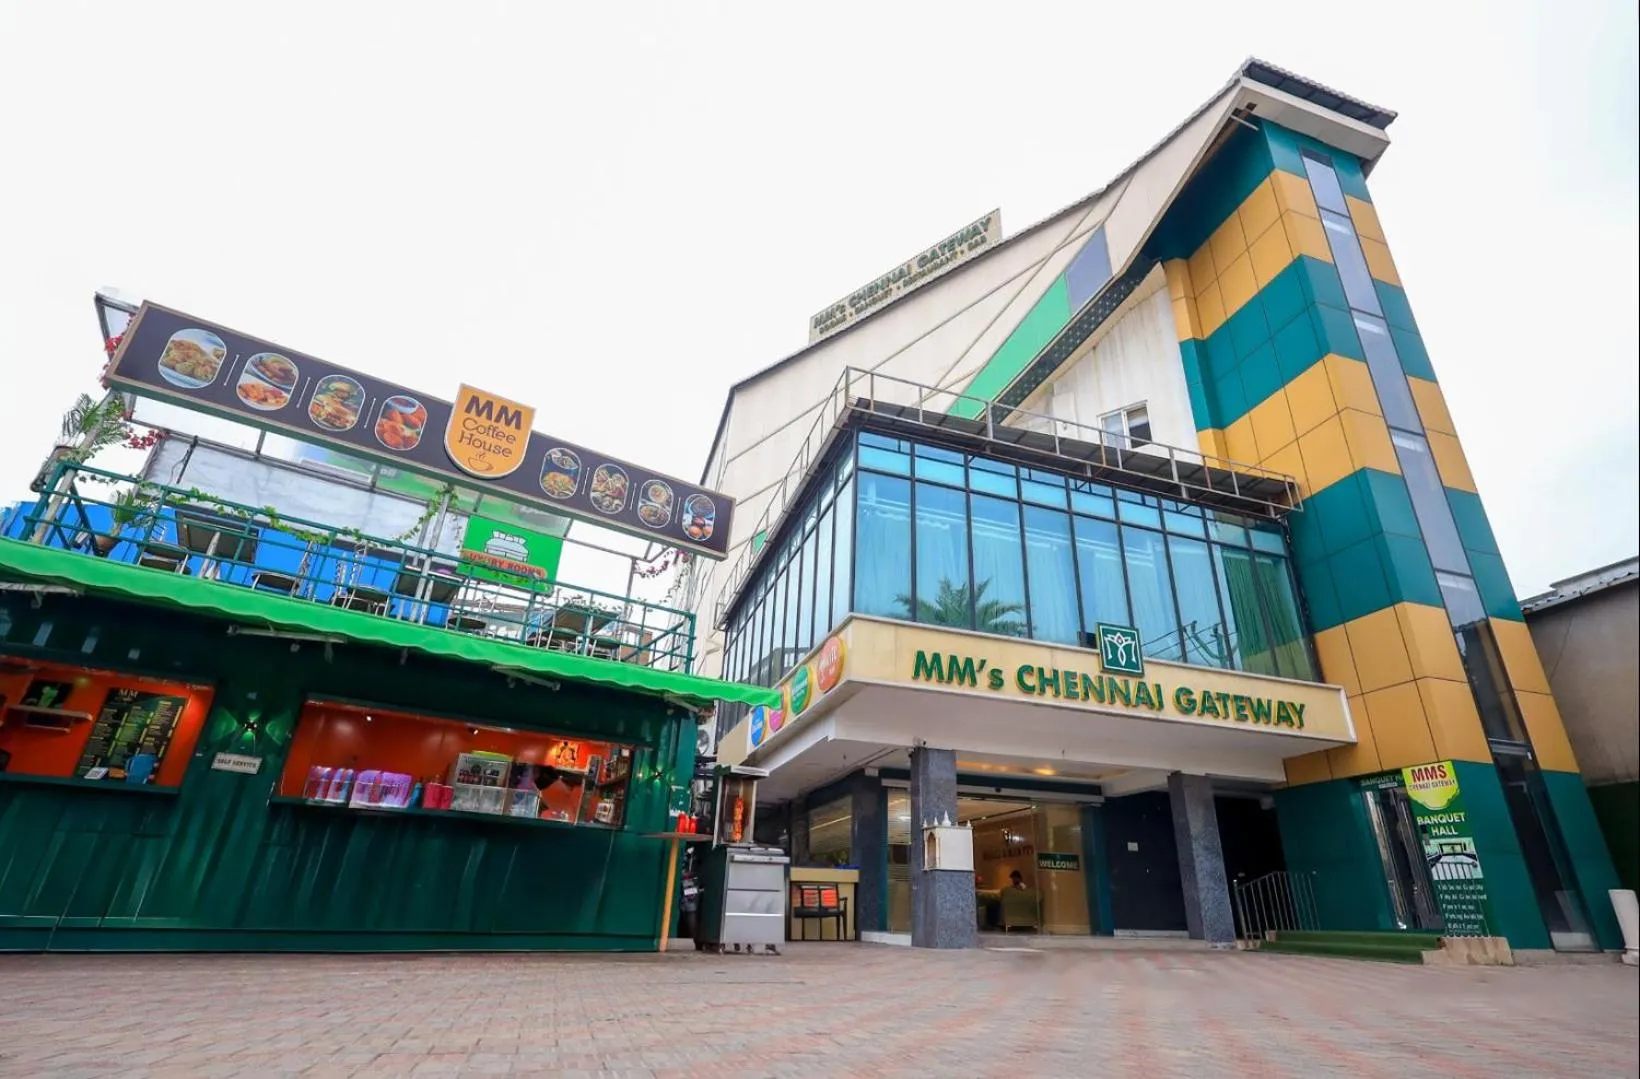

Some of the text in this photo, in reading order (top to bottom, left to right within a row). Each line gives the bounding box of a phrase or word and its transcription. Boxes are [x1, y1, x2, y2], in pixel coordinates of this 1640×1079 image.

[849, 264, 912, 308] CHENNAI
[917, 216, 992, 269] GATEWAY
[464, 395, 522, 430] MM
[458, 430, 513, 457] House
[462, 417, 517, 444] Coffee
[912, 650, 1306, 729] MM's CHENNAI GATEWAY
[1411, 765, 1448, 782] MMS
[1416, 812, 1466, 826] BANQUET
[1431, 825, 1459, 836] HALL
[1039, 859, 1080, 869] WELCOME
